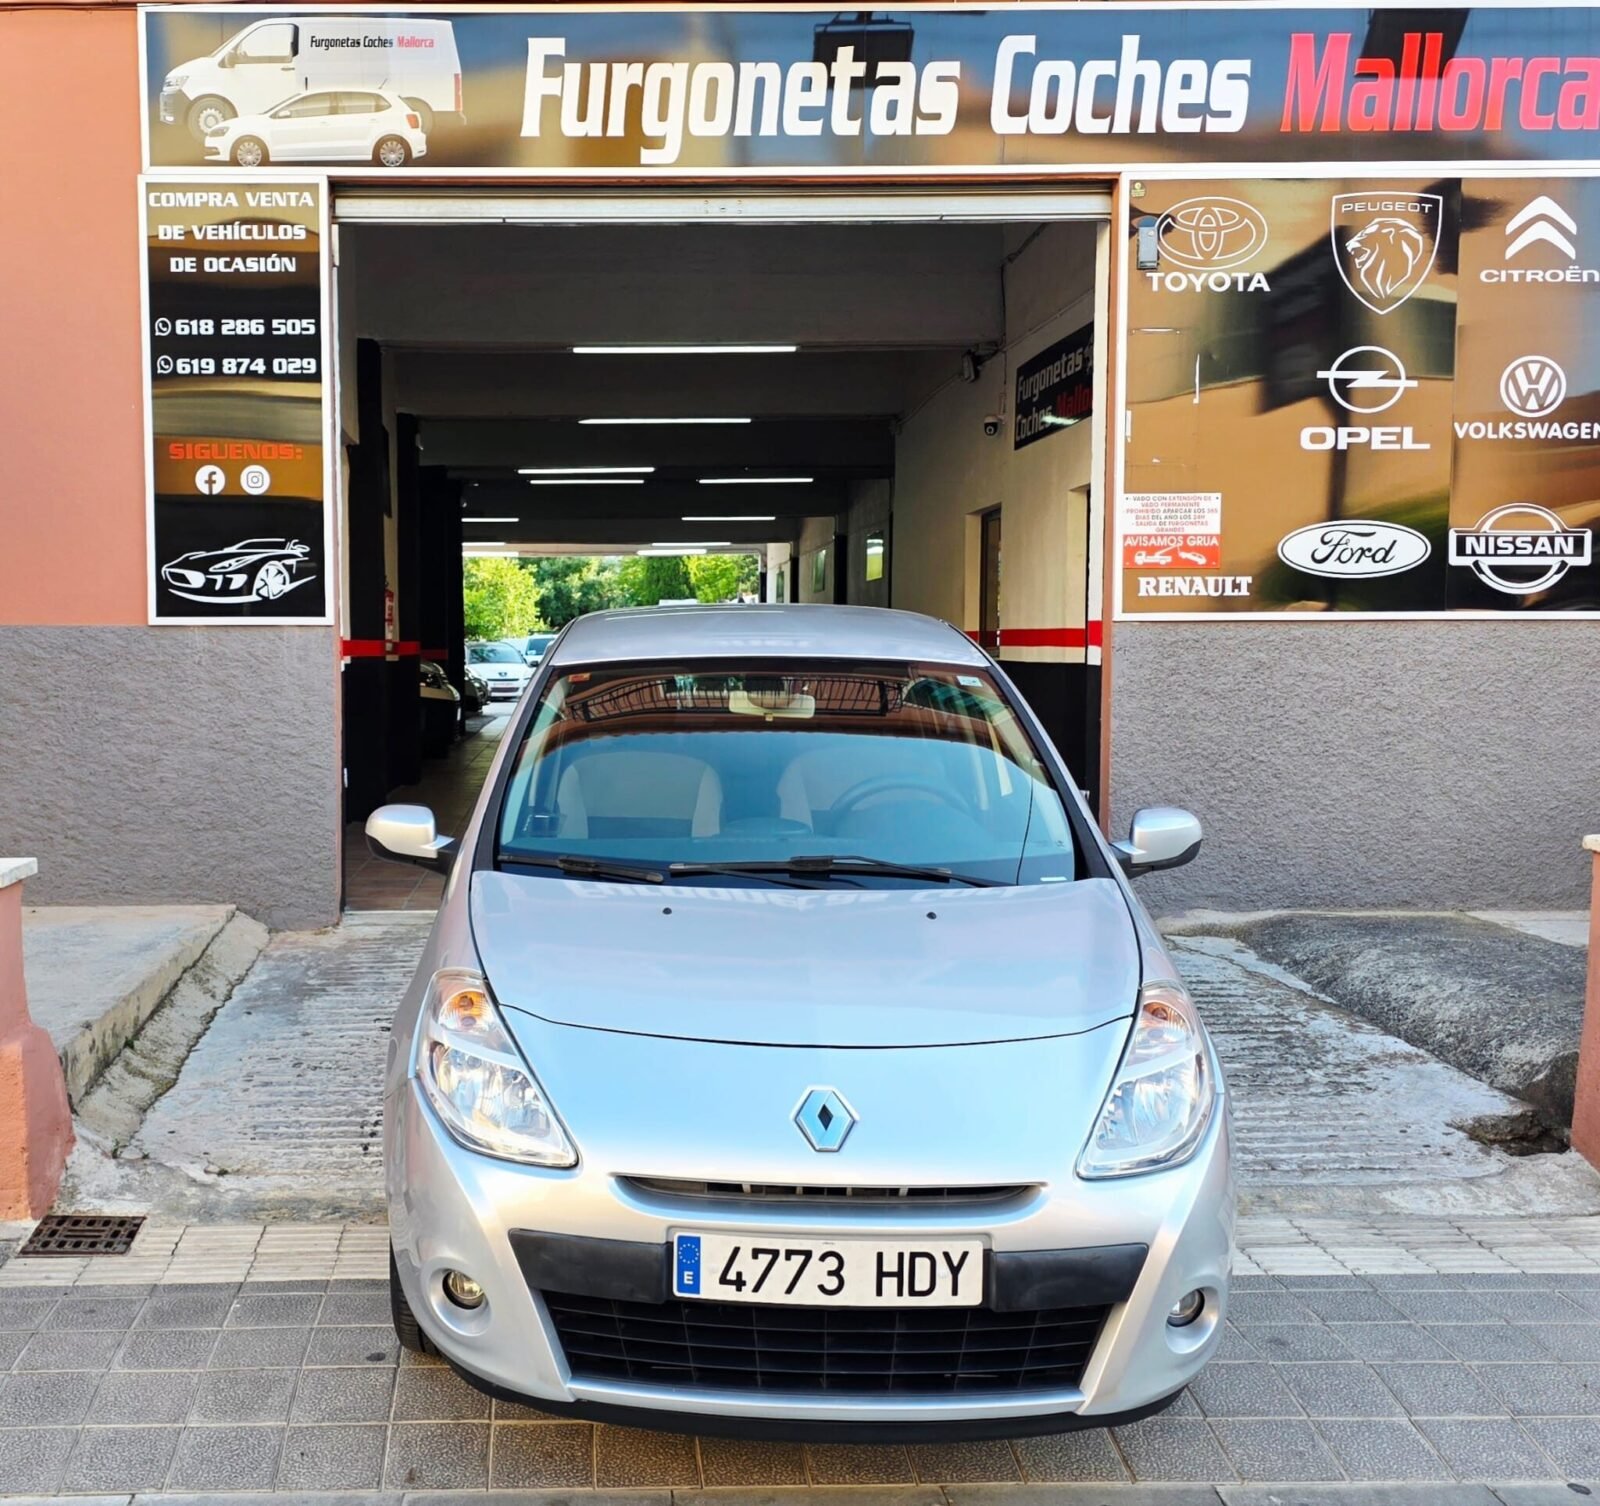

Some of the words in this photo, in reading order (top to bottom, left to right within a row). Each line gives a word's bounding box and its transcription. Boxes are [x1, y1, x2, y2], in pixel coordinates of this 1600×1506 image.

[310, 36, 361, 51] Furgonetas
[363, 36, 393, 48] Coches
[397, 36, 434, 48] Mallorca
[520, 37, 961, 165] Furgonetas
[990, 34, 1250, 134] Coches
[1280, 33, 1600, 132] Mallorca
[149, 192, 239, 207] COMPRA
[245, 191, 314, 207] VENTA
[1341, 201, 1433, 213] PEUGEOT
[158, 225, 185, 240] DE
[192, 221, 306, 240] VEHÍCULOS
[170, 257, 197, 272] DE
[204, 254, 296, 272] OCASIÓN
[1146, 272, 1271, 292] TOYOTA
[175, 319, 214, 335] 618
[221, 319, 265, 335] 286
[272, 319, 316, 335] 505
[176, 358, 215, 374] 619
[222, 358, 266, 374] 874
[273, 358, 317, 374] 029
[1017, 346, 1083, 404] Furgonetas
[1057, 384, 1093, 418] Mallo
[1300, 426, 1430, 450] OPEL
[169, 443, 304, 460] SIGUENOS:
[1124, 536, 1183, 546] AVISAMOS
[1186, 536, 1219, 546] GRUA
[1311, 529, 1398, 565] Ford
[1465, 536, 1574, 556] NISSAN
[1137, 576, 1252, 597] RENAULT
[683, 1271, 693, 1284] E
[719, 1246, 845, 1296] 4773
[875, 1250, 969, 1297] HDY
